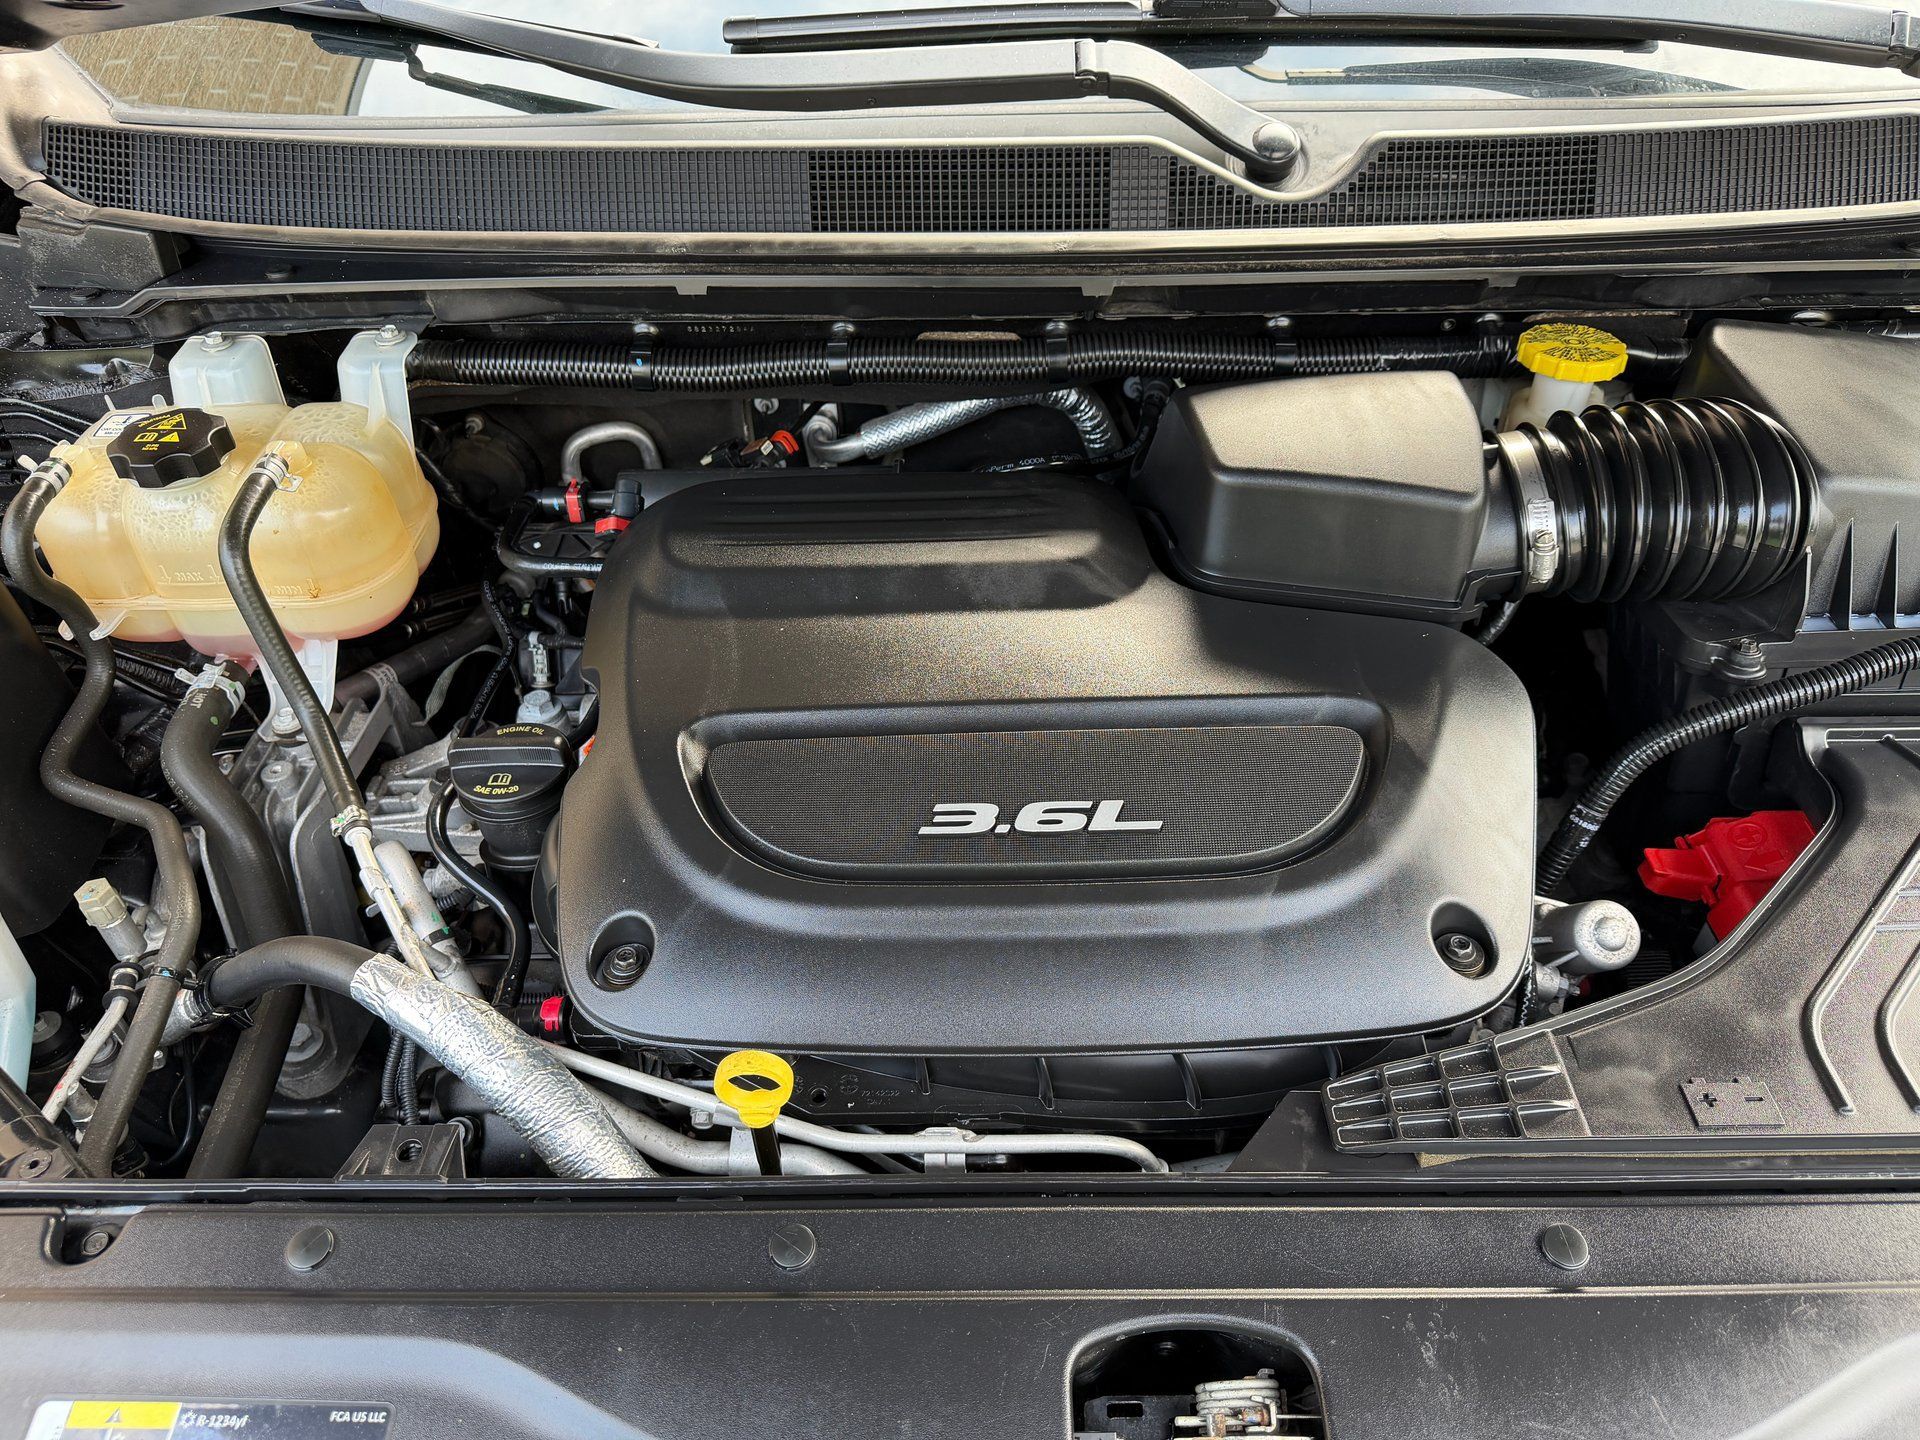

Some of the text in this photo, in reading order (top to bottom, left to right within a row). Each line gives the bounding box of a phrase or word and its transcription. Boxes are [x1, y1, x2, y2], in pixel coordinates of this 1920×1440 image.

[496, 725, 545, 736] ENGINE OIL
[473, 785, 519, 795] SAE 0W-20
[918, 800, 1164, 835] 3.6L
[195, 1414, 249, 1430] R-1234yf
[329, 1411, 388, 1423] FCA US LLC
